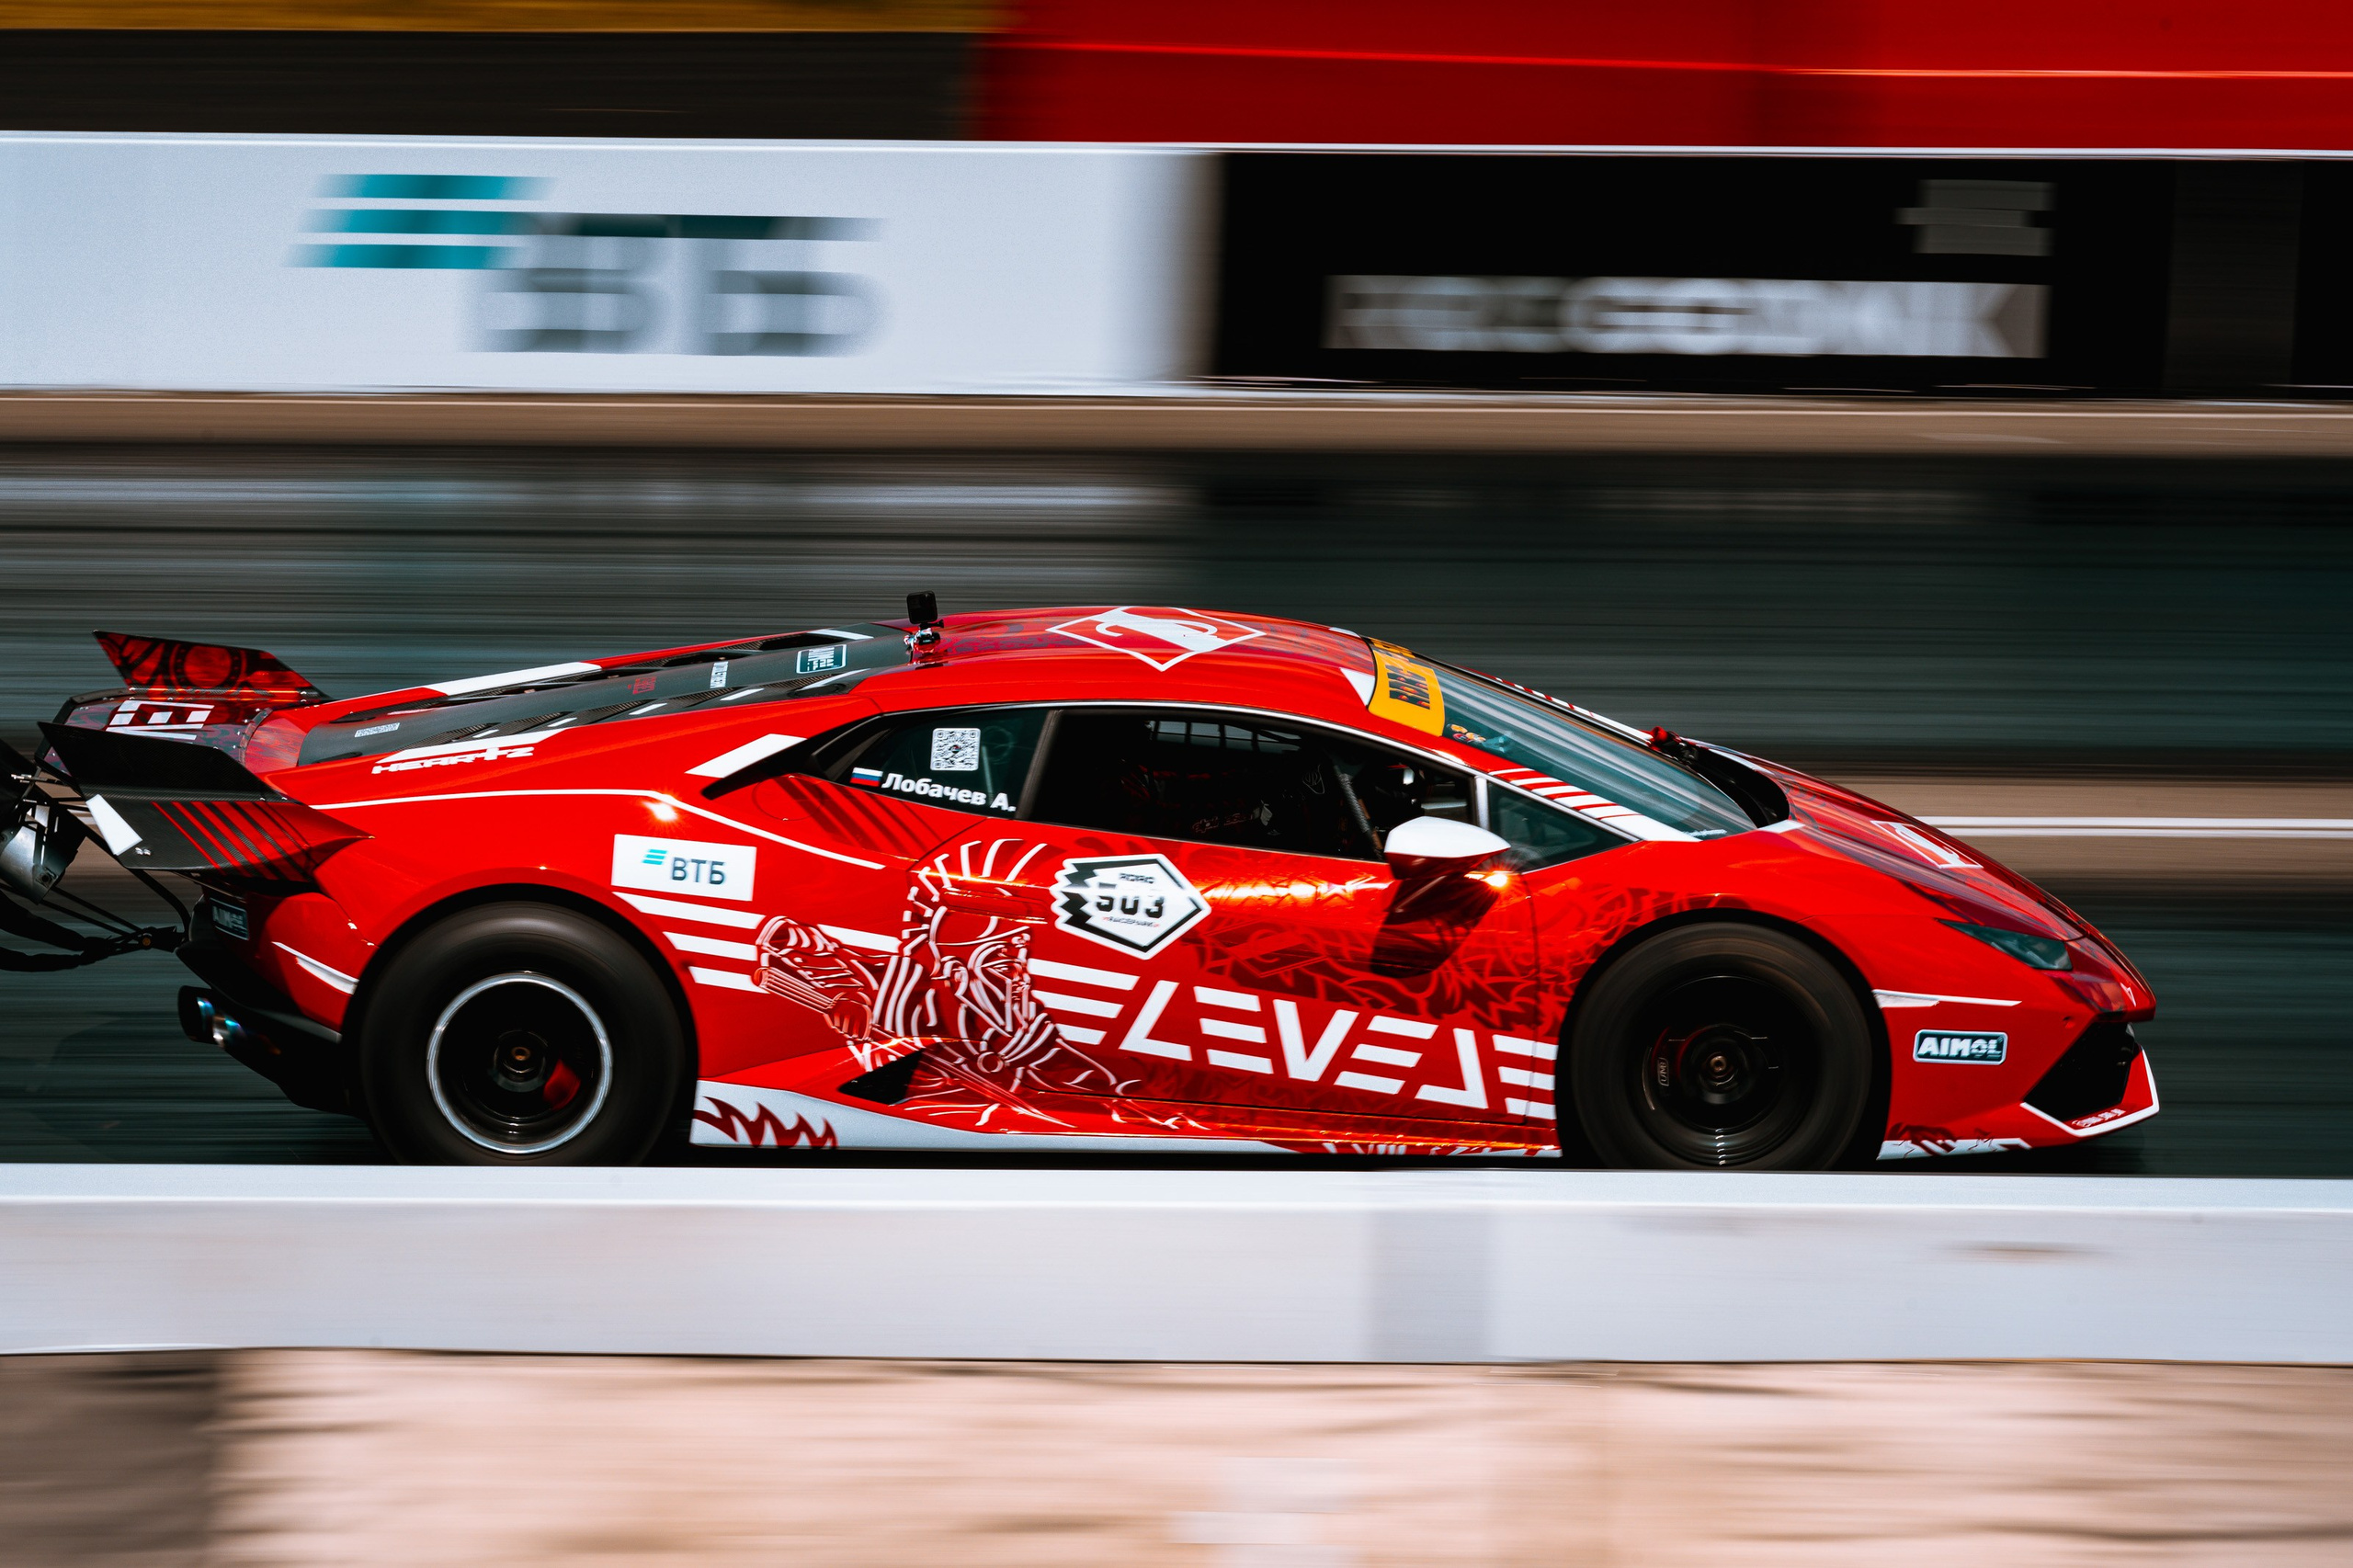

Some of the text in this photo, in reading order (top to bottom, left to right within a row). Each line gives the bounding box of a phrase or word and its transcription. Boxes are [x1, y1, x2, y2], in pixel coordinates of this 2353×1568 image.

[881, 772, 987, 806] Лобачев
[671, 857, 726, 885] ВТБ
[1917, 1037, 2002, 1058] AIMOL
